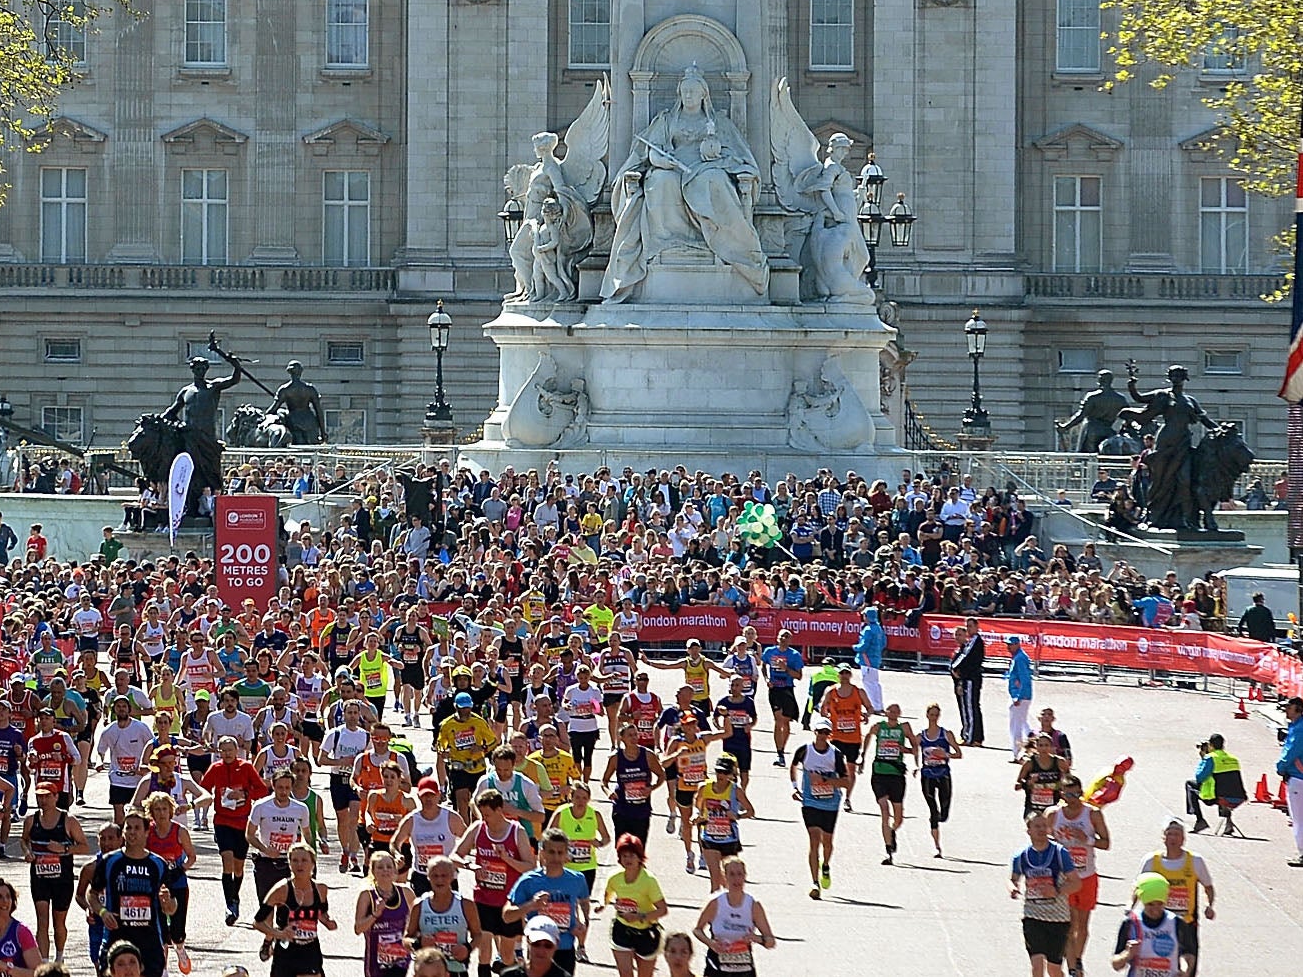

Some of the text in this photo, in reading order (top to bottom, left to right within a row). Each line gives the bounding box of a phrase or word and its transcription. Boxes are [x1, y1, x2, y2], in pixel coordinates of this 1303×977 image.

[220, 544, 271, 564] 200
[223, 566, 268, 575] METRES
[227, 577, 264, 587] TO GO
[643, 614, 727, 627] london marathon
[780, 619, 809, 634] virgin
[810, 621, 843, 636] money
[1079, 637, 1128, 651] marathon
[125, 865, 150, 875] PAUL
[124, 908, 148, 918] 4617
[424, 916, 459, 924] PETER
